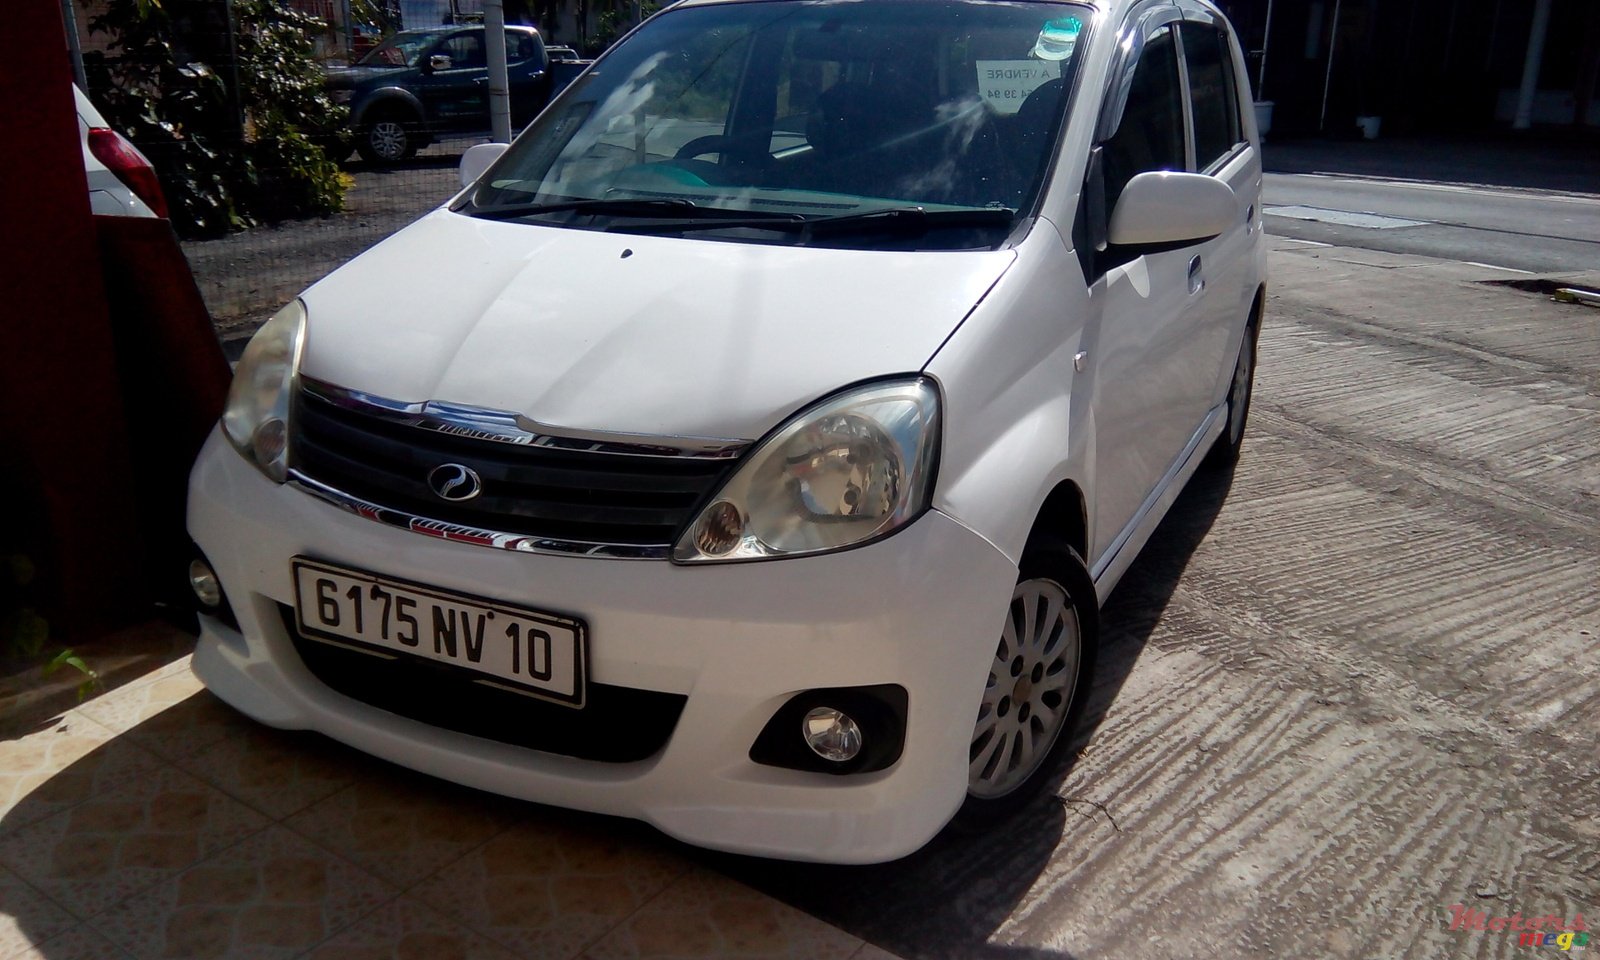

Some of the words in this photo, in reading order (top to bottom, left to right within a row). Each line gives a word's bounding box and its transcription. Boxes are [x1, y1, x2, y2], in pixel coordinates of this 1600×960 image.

[316, 578, 418, 647] 6175
[432, 605, 486, 663] NV
[505, 623, 552, 682] 10
